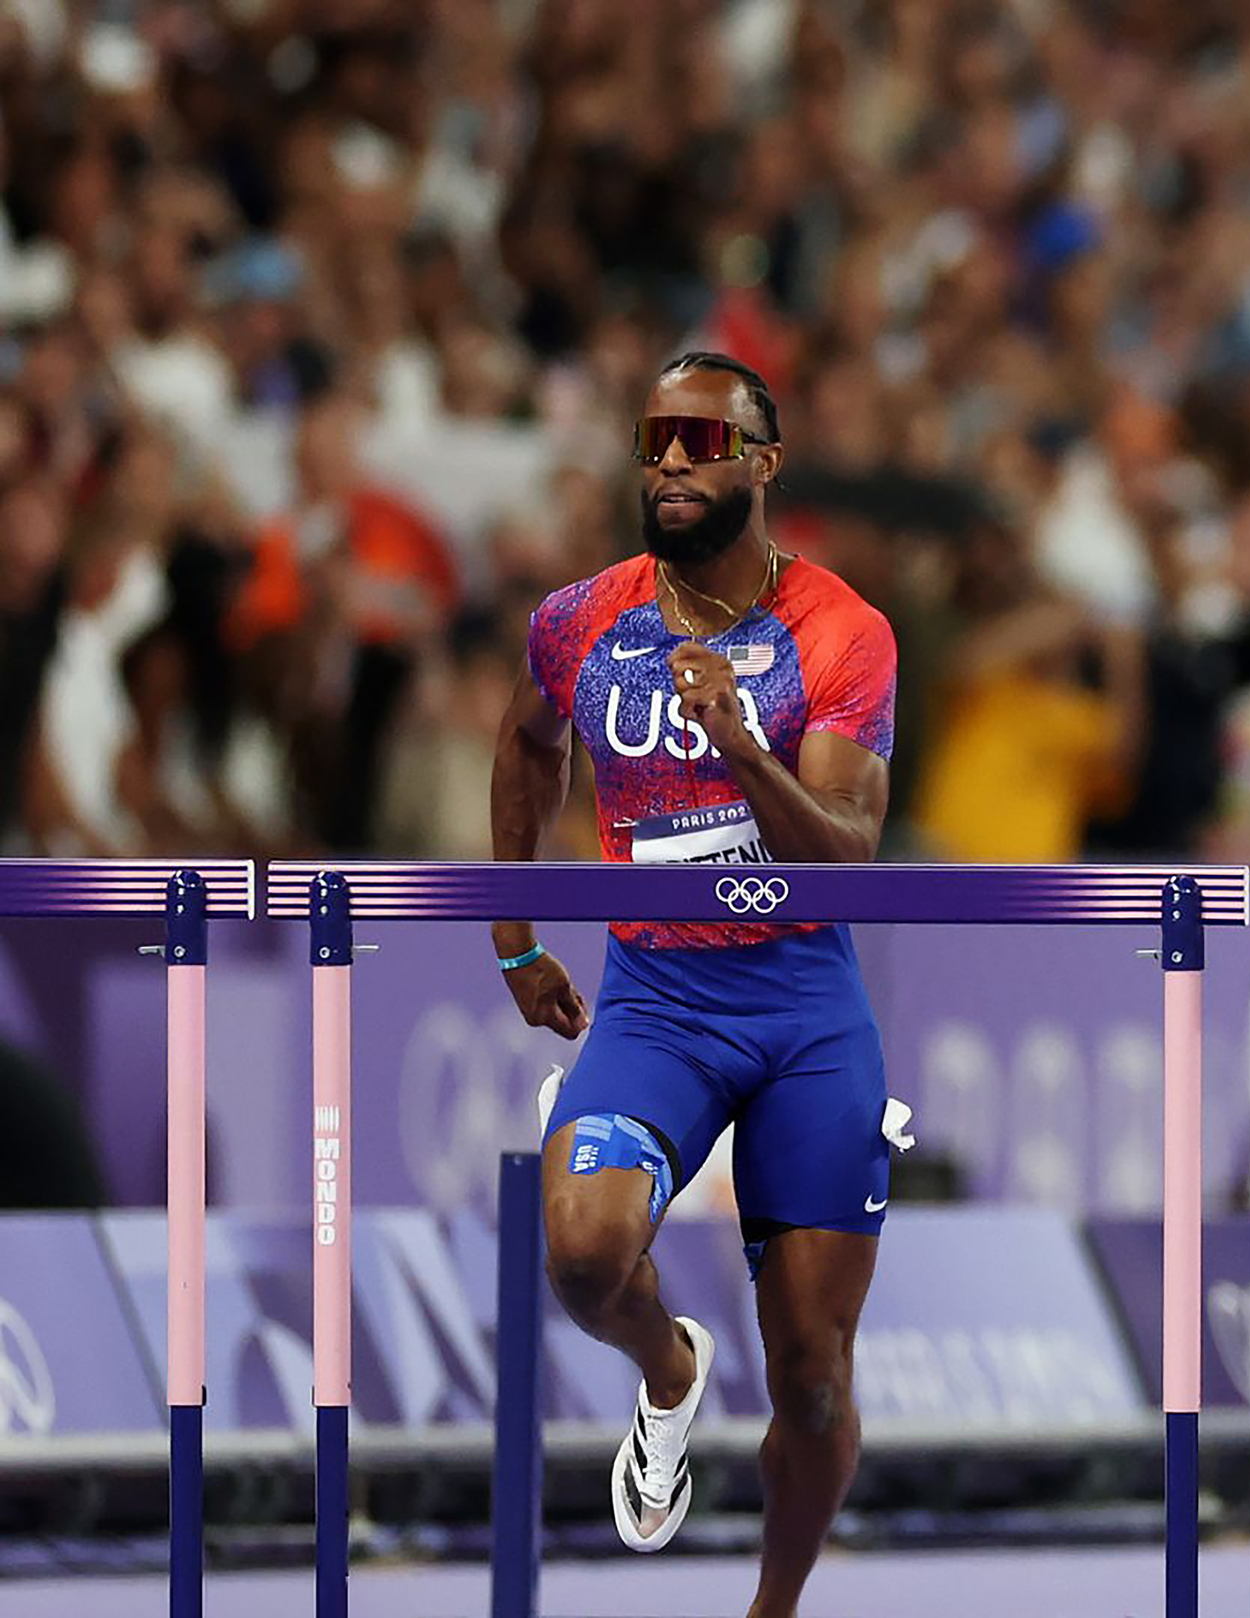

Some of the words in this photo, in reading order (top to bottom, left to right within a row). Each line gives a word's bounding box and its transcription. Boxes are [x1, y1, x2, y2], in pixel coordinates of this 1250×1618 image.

[671, 811, 715, 830] PARIS
[718, 805, 751, 823] 202
[314, 1138, 340, 1246] MONDO
